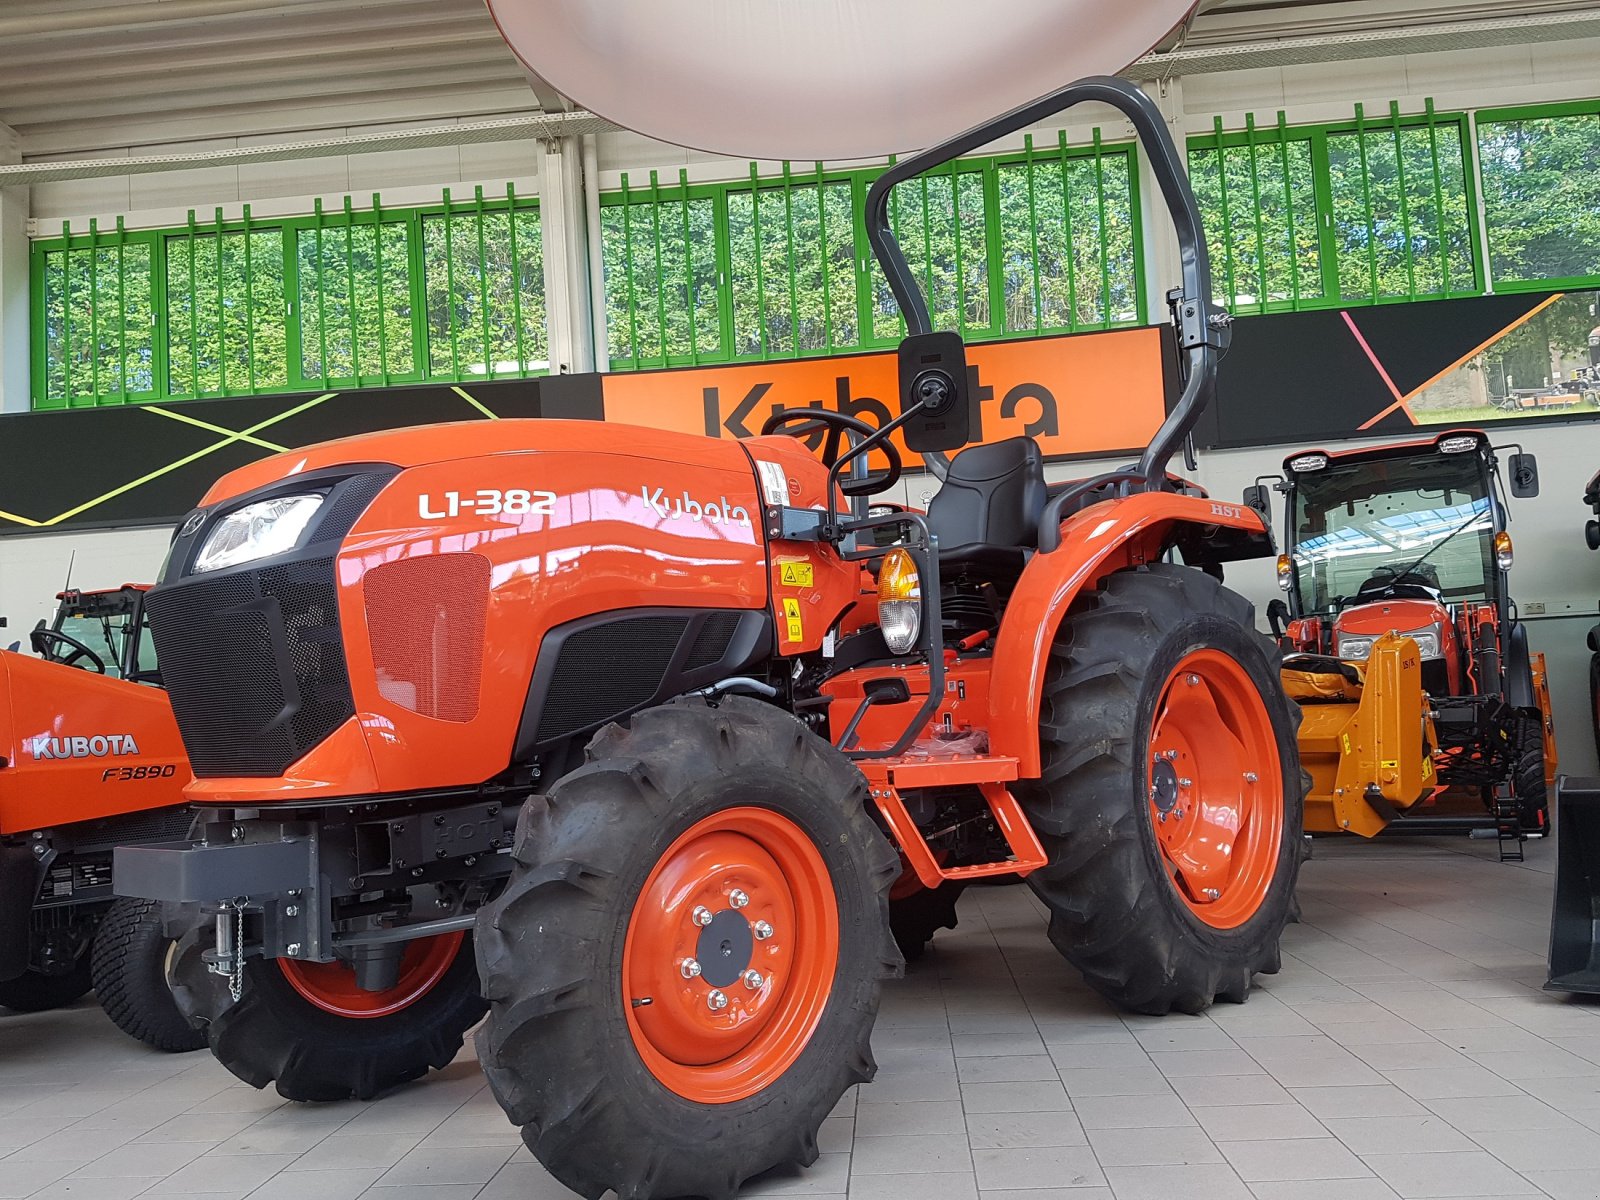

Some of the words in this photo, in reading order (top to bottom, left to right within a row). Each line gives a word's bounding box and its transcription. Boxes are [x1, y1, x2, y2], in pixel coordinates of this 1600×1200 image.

[703, 365, 1060, 453] Kubta
[418, 489, 557, 519] L1-382
[641, 485, 751, 527] Kubota
[1210, 503, 1241, 519] HST
[33, 734, 140, 760] KUBOTA
[102, 764, 176, 782] F3890
